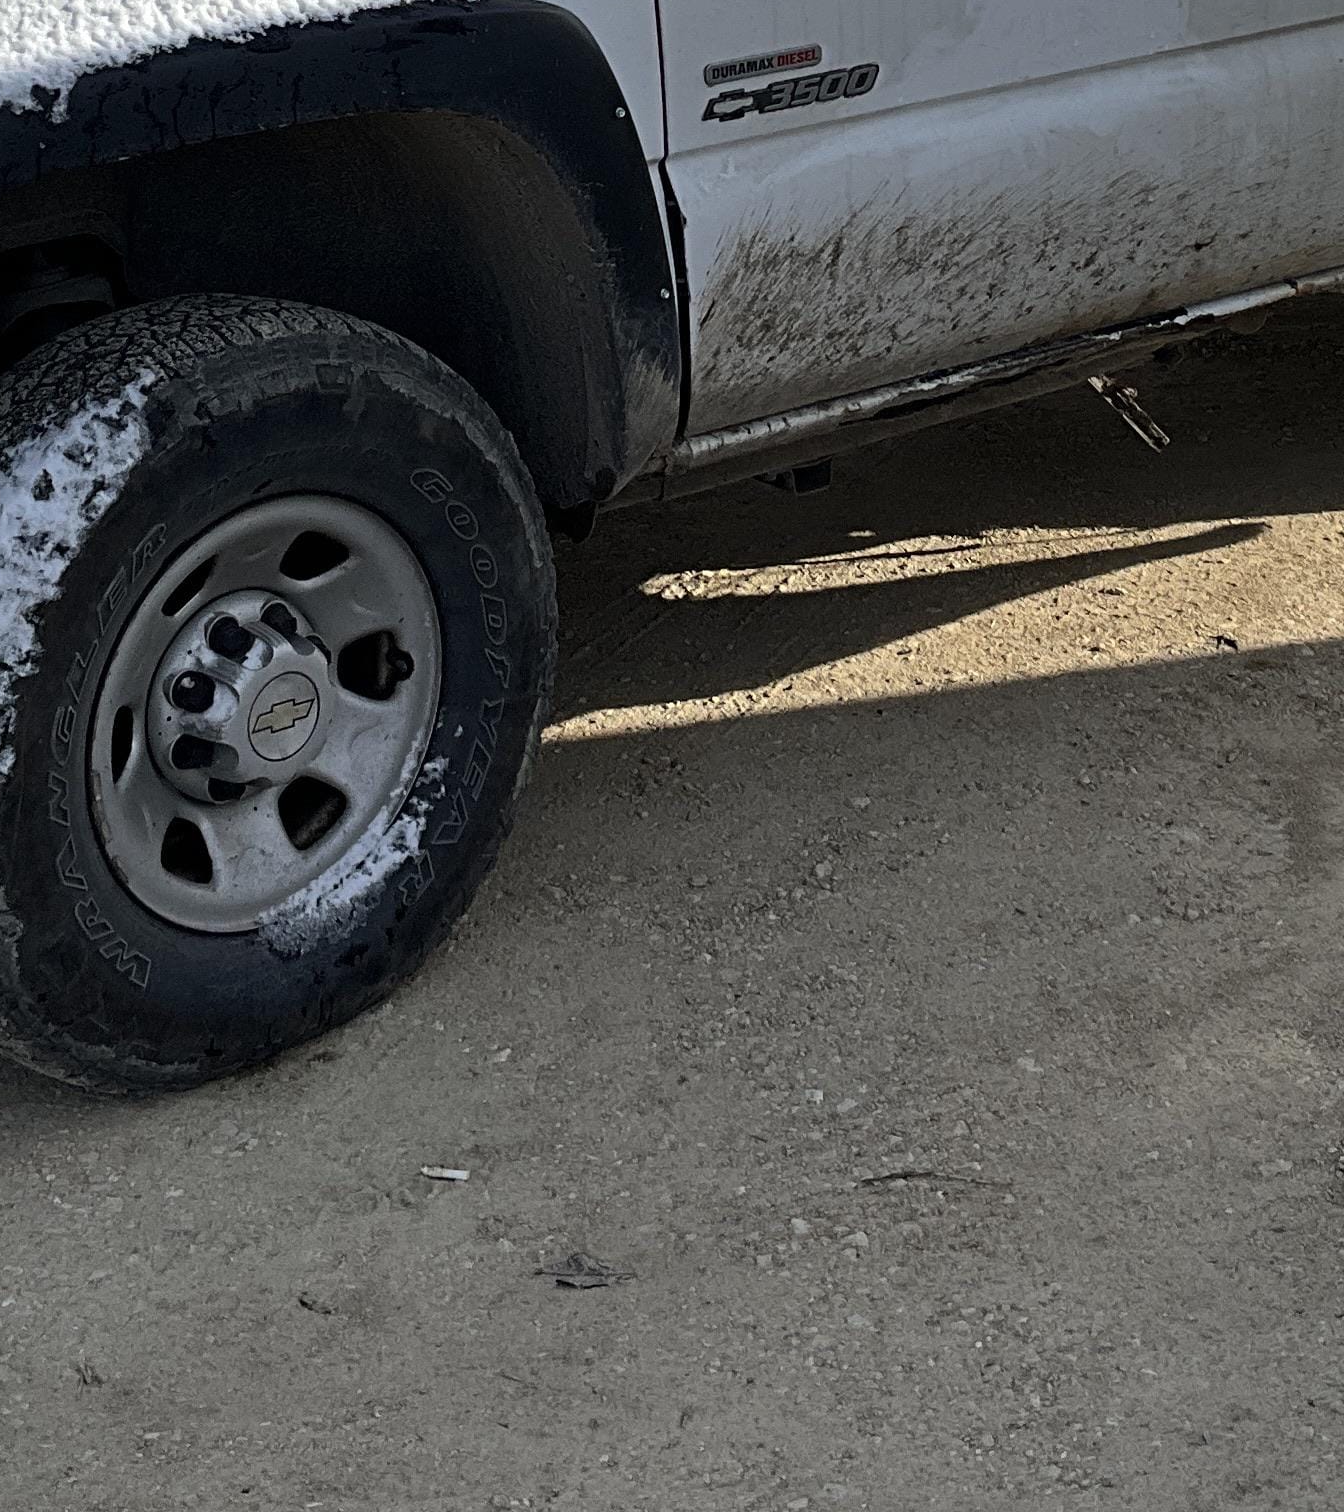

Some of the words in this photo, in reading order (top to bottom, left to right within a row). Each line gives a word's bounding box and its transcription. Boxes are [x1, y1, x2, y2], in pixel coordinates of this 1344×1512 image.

[712, 57, 775, 80] DURAMAX
[776, 48, 819, 67] DIESEL
[761, 63, 879, 113] 3500
[48, 522, 168, 989] WRANGLER
